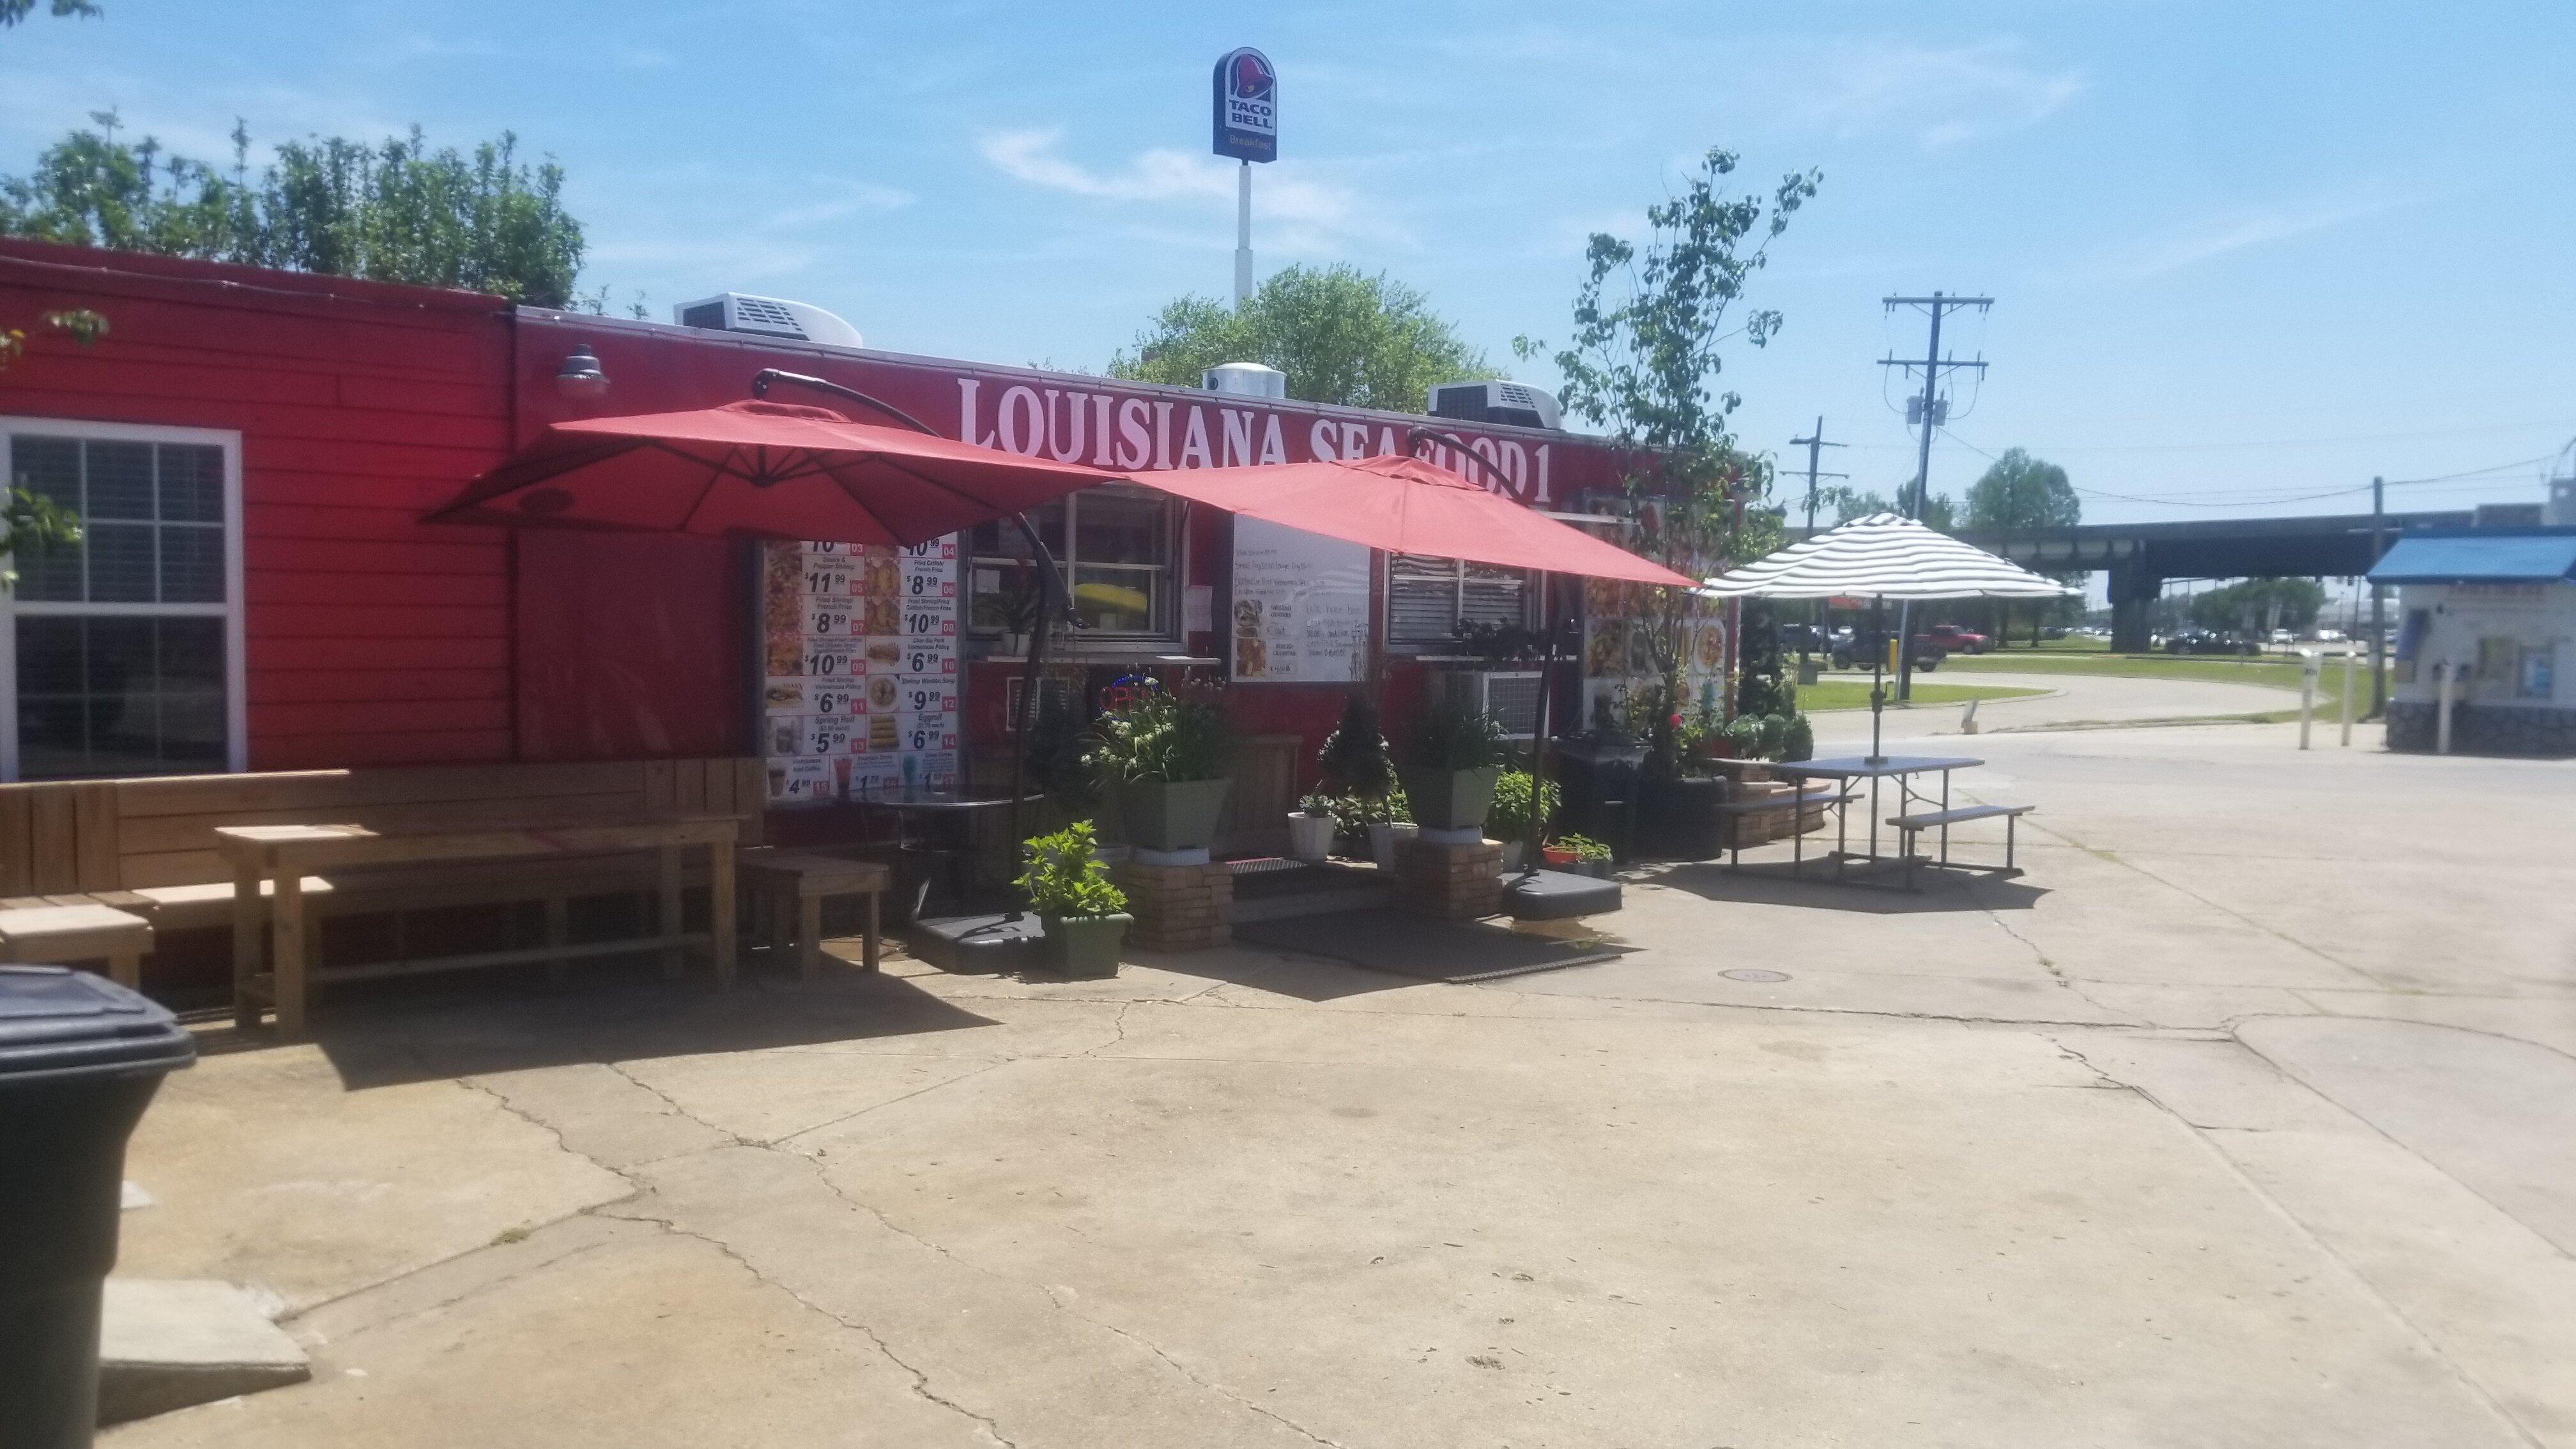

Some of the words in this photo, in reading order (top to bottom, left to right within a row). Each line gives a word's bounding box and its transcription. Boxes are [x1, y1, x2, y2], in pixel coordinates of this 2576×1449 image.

[1229, 99, 1271, 116] TACO
[1232, 112, 1272, 129] BELL
[1229, 134, 1271, 151] Breakfast
[958, 378, 1287, 470] LOUISIANA
[944, 547, 954, 556] 04
[852, 623, 864, 632] 07
[852, 663, 864, 671] 09
[945, 662, 954, 670] 10
[944, 699, 954, 708] 12
[815, 716, 838, 725] Spring
[840, 715, 855, 723] Roll
[944, 737, 954, 746] 14
